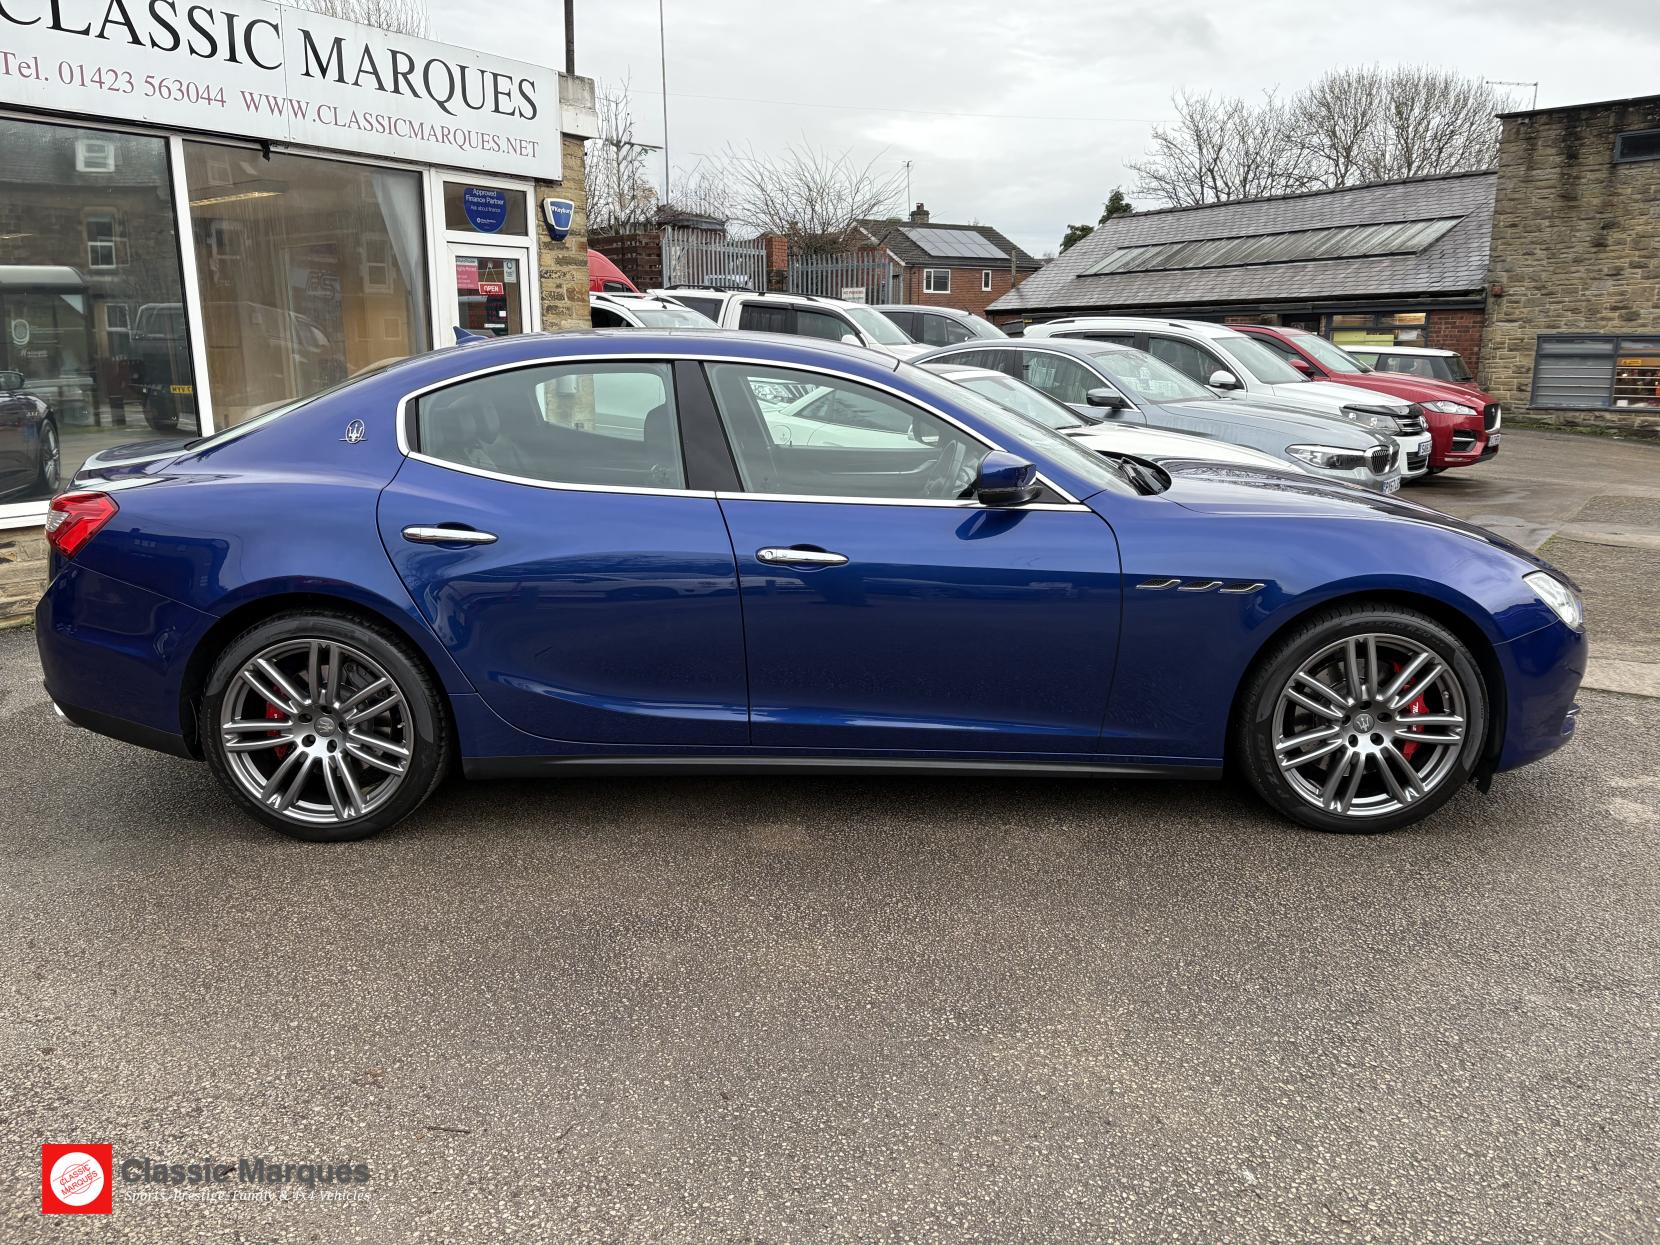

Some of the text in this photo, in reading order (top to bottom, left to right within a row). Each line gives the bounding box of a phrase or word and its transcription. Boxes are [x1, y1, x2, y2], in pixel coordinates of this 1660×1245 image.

[297, 28, 538, 121] MARQUES
[1, 51, 539, 158] Tel. 01423 563044 WWW.CLASSICMARQUES.NET
[465, 194, 504, 205] Finance Partner
[472, 188, 497, 197] Approved
